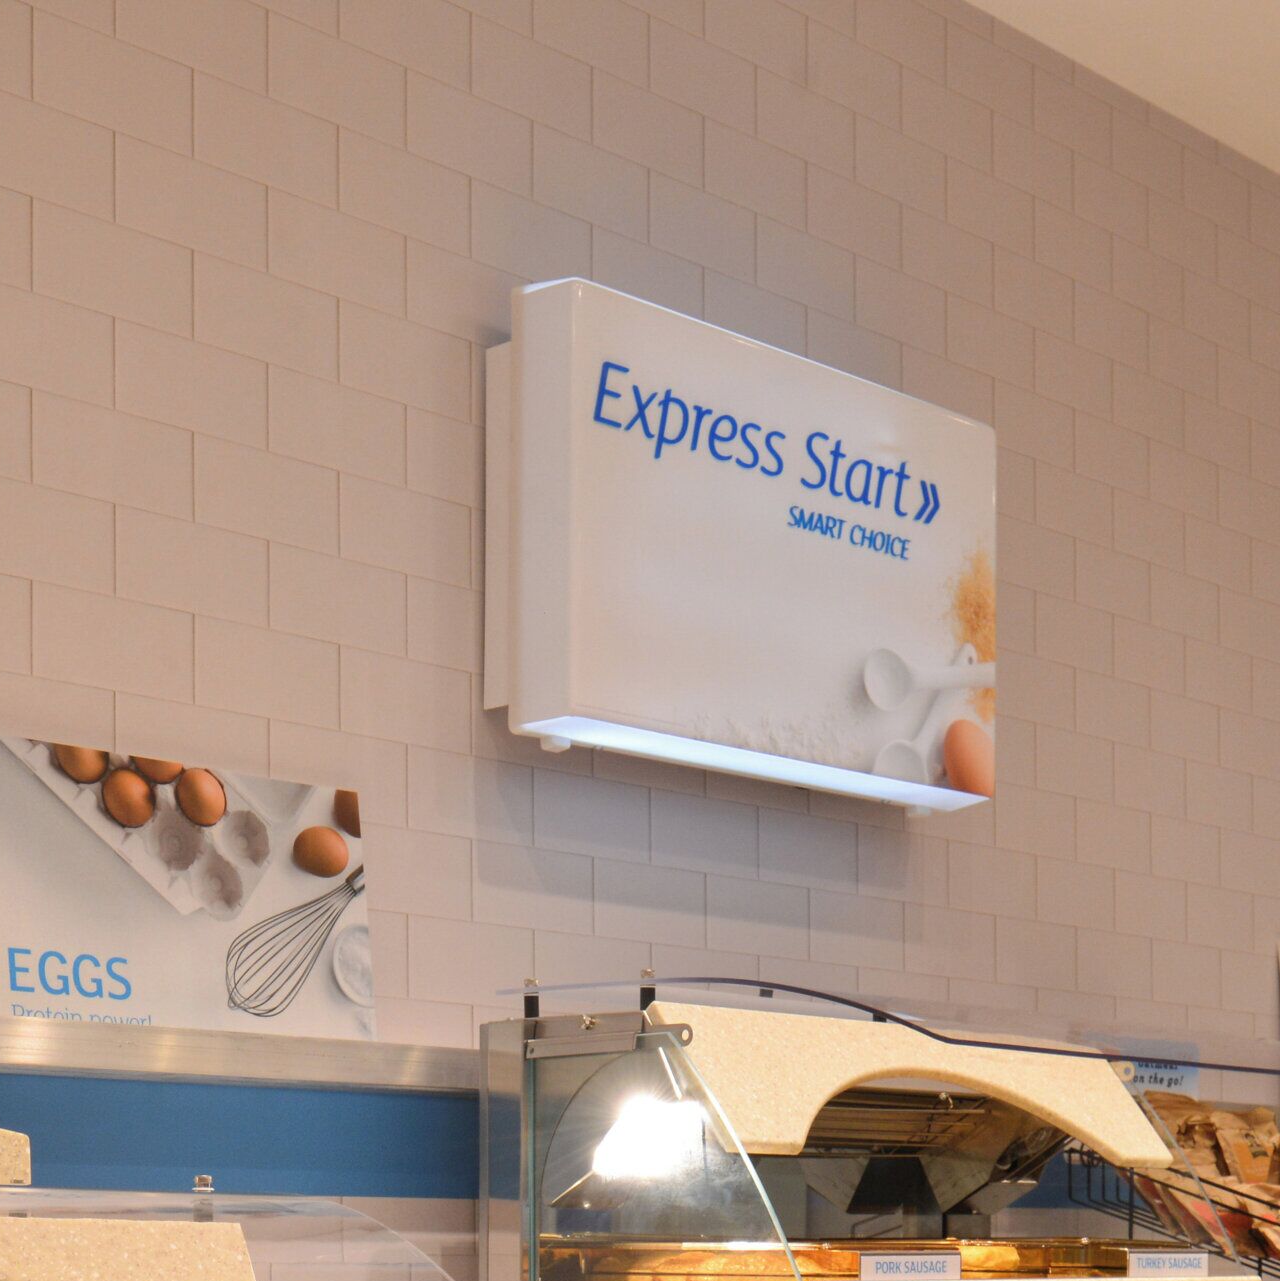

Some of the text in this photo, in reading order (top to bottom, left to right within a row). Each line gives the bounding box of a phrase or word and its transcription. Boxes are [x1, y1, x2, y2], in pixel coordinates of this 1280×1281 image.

[593, 361, 911, 517] Express Start
[787, 505, 910, 560] SMART CHOICE
[8, 947, 132, 1000] EGGS
[1148, 1071, 1164, 1085] the
[875, 1260, 947, 1274] PORK SAUSAGE
[1136, 1257, 1202, 1269] TURKEY SAUSAGE
